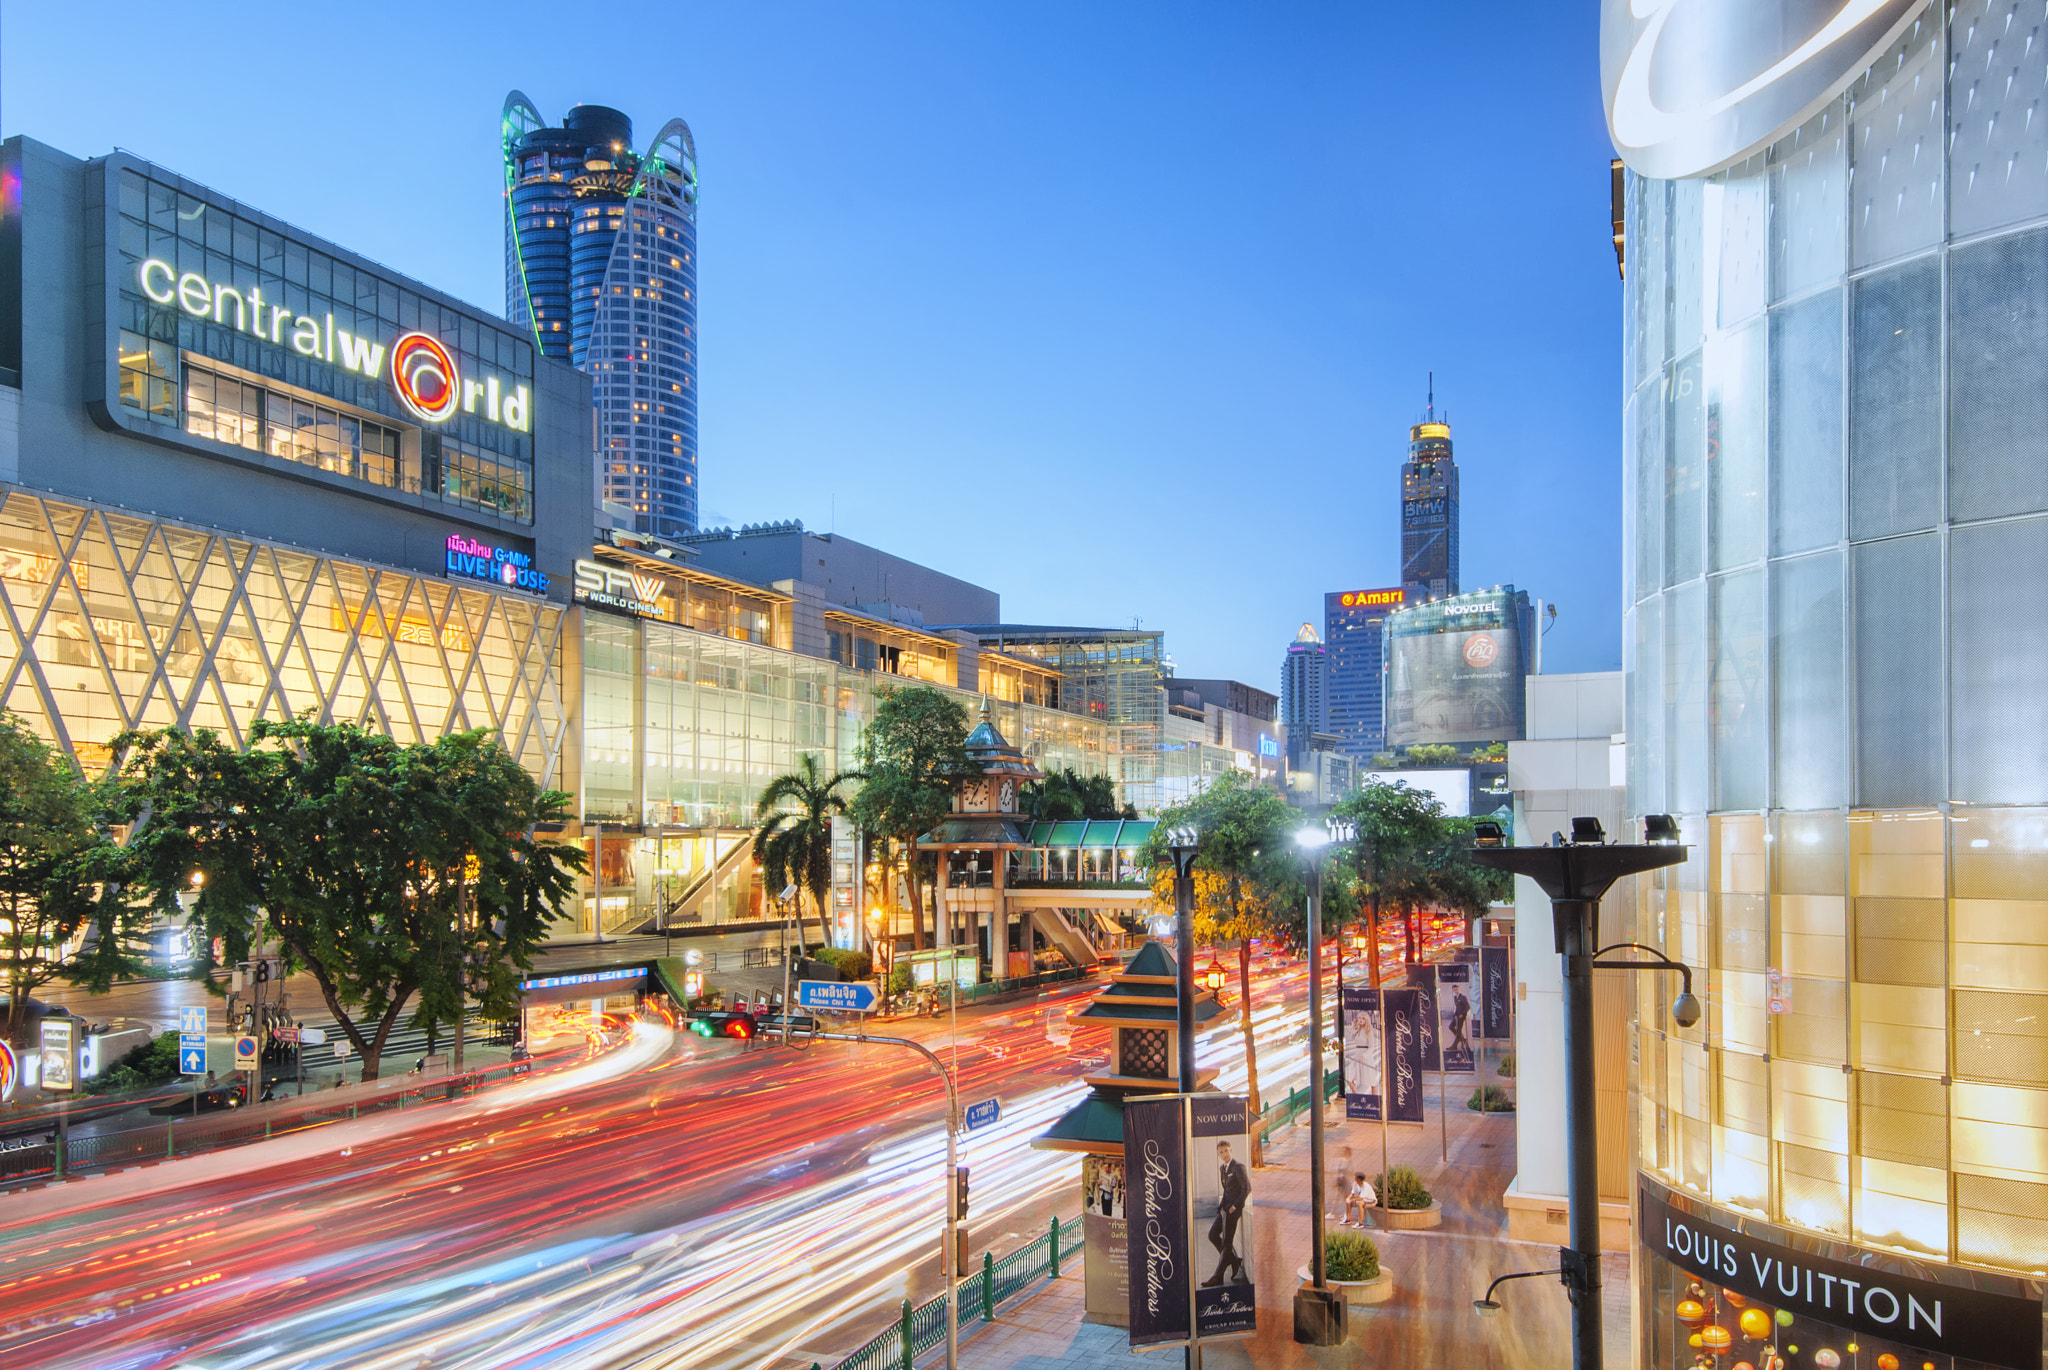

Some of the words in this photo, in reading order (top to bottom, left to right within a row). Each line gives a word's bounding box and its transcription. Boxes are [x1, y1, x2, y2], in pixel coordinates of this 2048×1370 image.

[1405, 501, 1445, 516] BMW
[1412, 515, 1445, 525] SERIES
[447, 550, 486, 577] LIVE
[575, 588, 589, 598] SF
[590, 592, 627, 607] WORLD
[627, 601, 664, 616] CINEMA
[1355, 591, 1403, 606] Amari
[1445, 600, 1500, 615] NOVOTEL
[1196, 1115, 1218, 1123] NOW
[1220, 1113, 1245, 1122] OPEN
[1143, 1139, 1173, 1218] Brooks
[1145, 1218, 1174, 1317] Brothers
[1666, 1218, 1737, 1276] LOUIS
[1751, 1252, 1941, 1338] VUITTON
